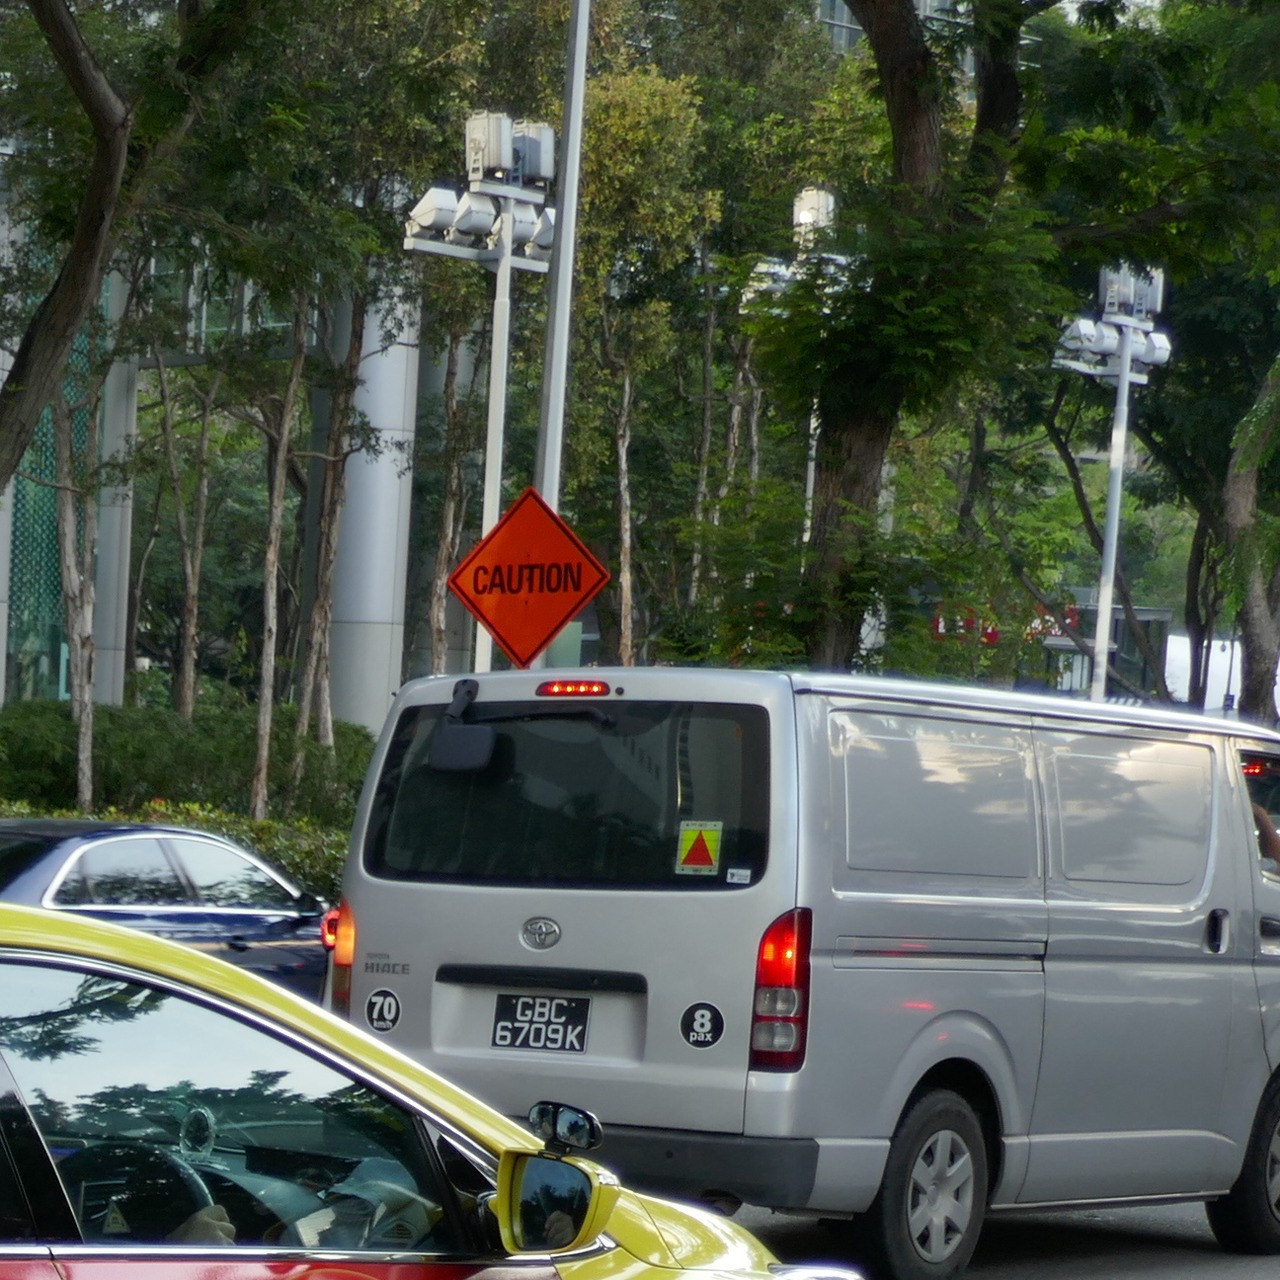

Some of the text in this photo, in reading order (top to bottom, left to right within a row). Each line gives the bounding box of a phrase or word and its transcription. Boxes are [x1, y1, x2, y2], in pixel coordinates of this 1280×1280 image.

[473, 562, 582, 596] CAUTION
[364, 962, 411, 975] HIACE
[370, 996, 397, 1021] 70
[515, 998, 568, 1024] GBC
[693, 1009, 711, 1034] 8
[495, 1022, 583, 1050] 6709K
[689, 1030, 713, 1043] pax
